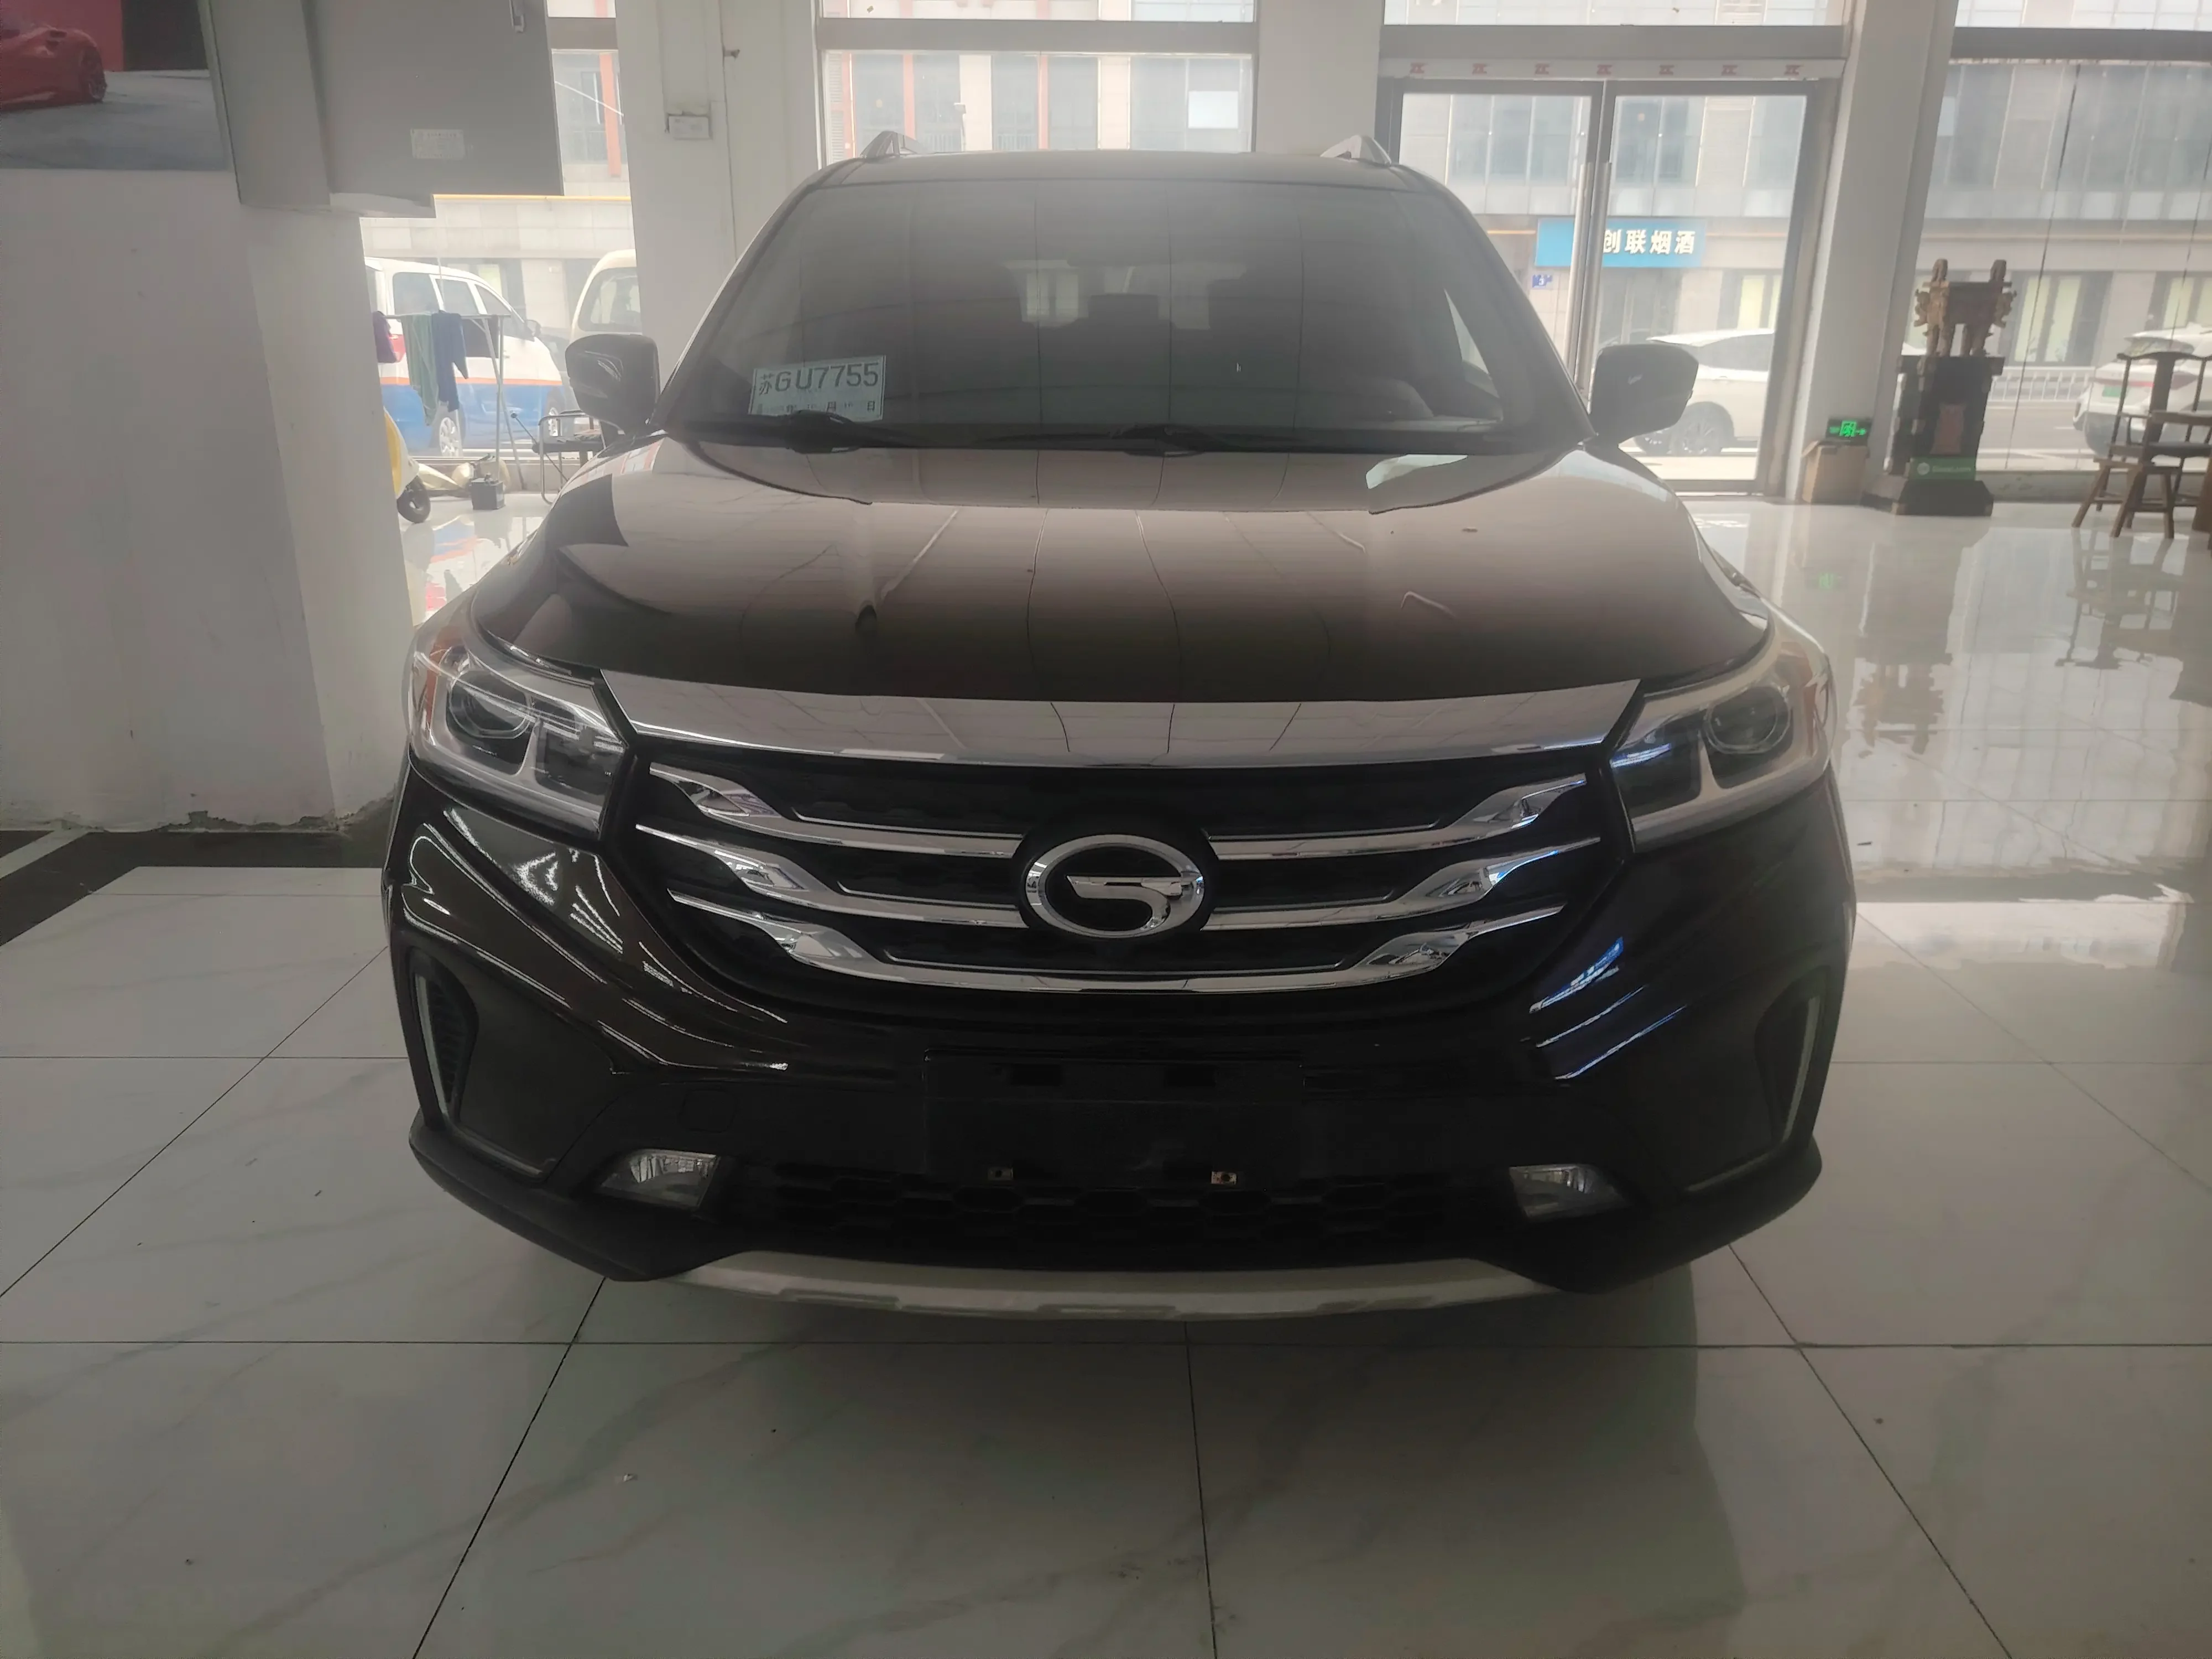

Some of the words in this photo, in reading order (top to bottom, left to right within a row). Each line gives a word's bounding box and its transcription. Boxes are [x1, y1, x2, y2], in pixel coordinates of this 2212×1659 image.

[1603, 229, 1695, 254] 创联烟酒
[759, 362, 879, 395] 苏GU7755
